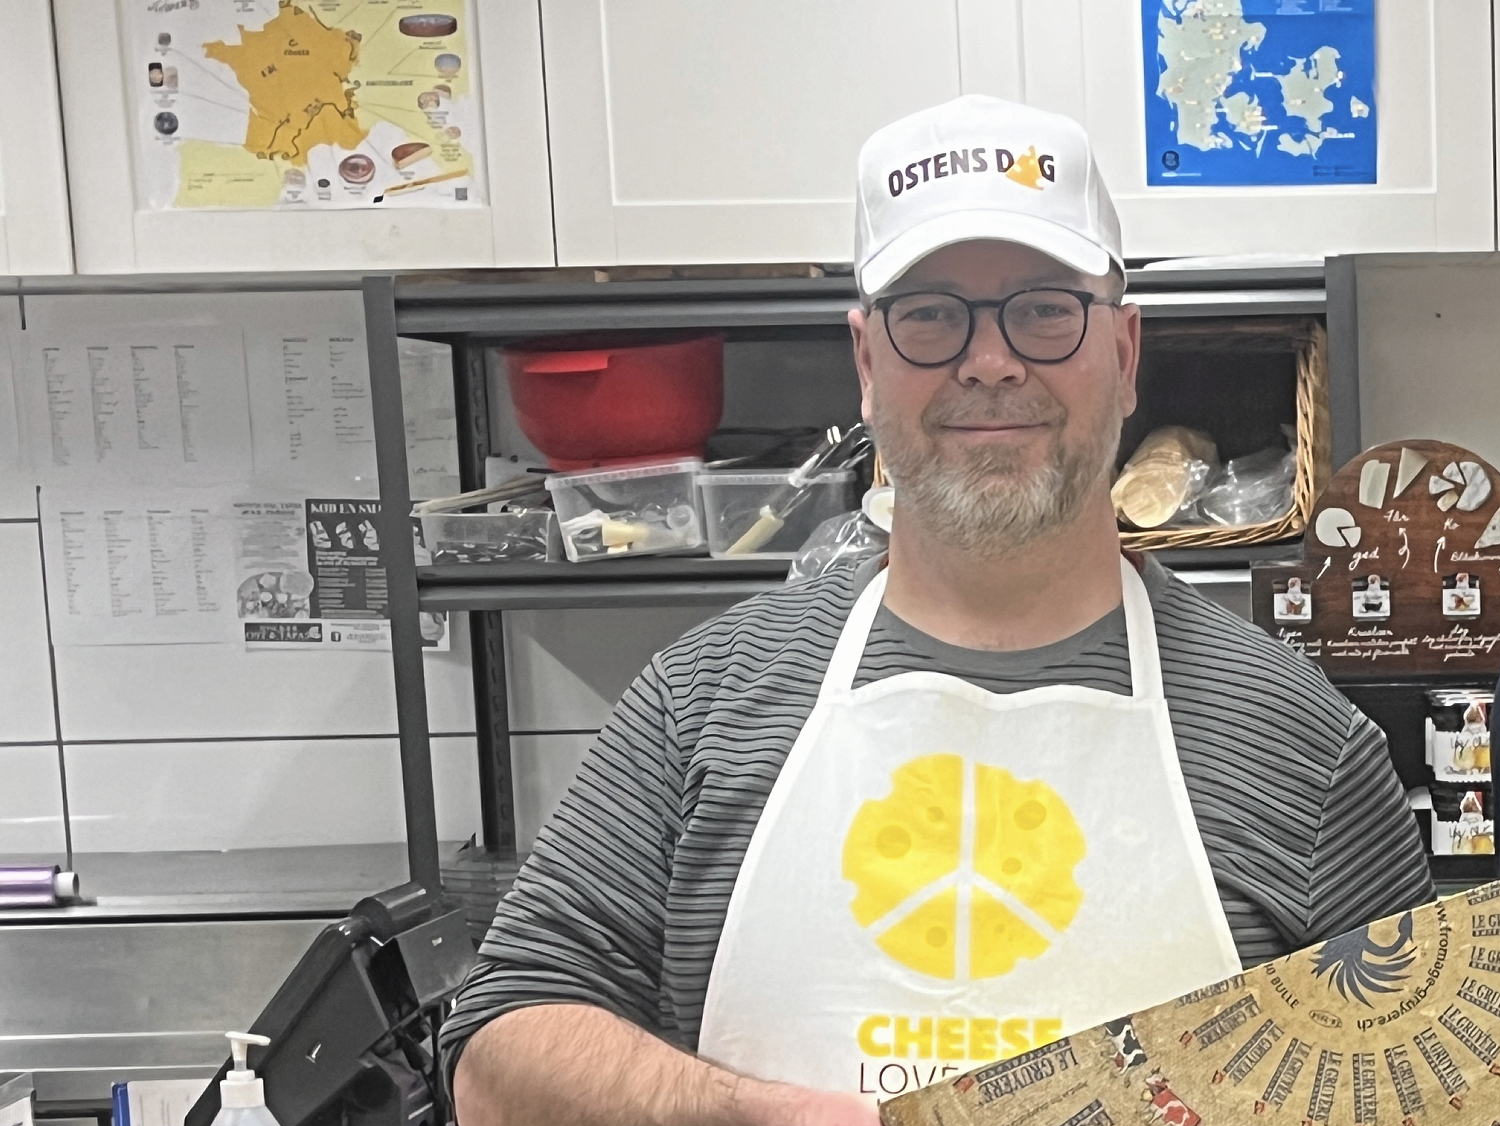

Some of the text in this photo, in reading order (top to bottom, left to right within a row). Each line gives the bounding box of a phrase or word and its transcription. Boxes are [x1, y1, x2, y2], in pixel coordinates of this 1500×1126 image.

[888, 148, 988, 197] OSTENS
[1471, 914, 1485, 929] LE
[1270, 976, 1300, 1009] BULLE
[860, 1063, 958, 1095] LOV
